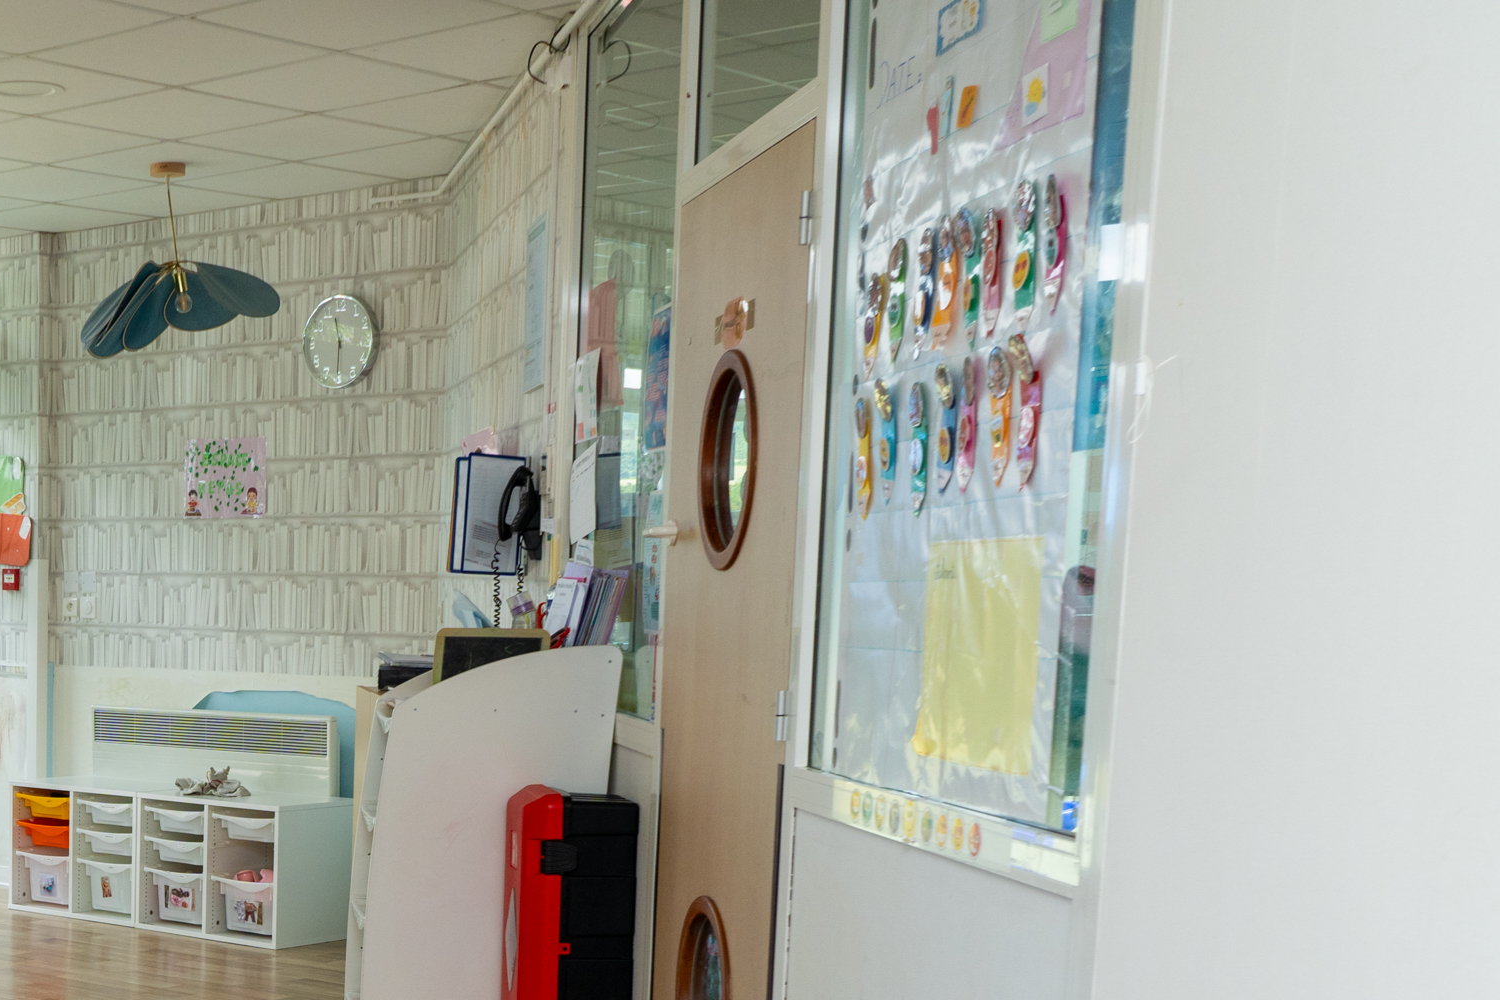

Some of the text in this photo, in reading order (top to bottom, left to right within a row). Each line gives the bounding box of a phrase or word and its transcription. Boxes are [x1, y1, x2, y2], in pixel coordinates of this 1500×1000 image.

[335, 299, 346, 312] 12
[202, 452, 248, 468] ESPACE
[198, 481, 241, 495] REPAS
